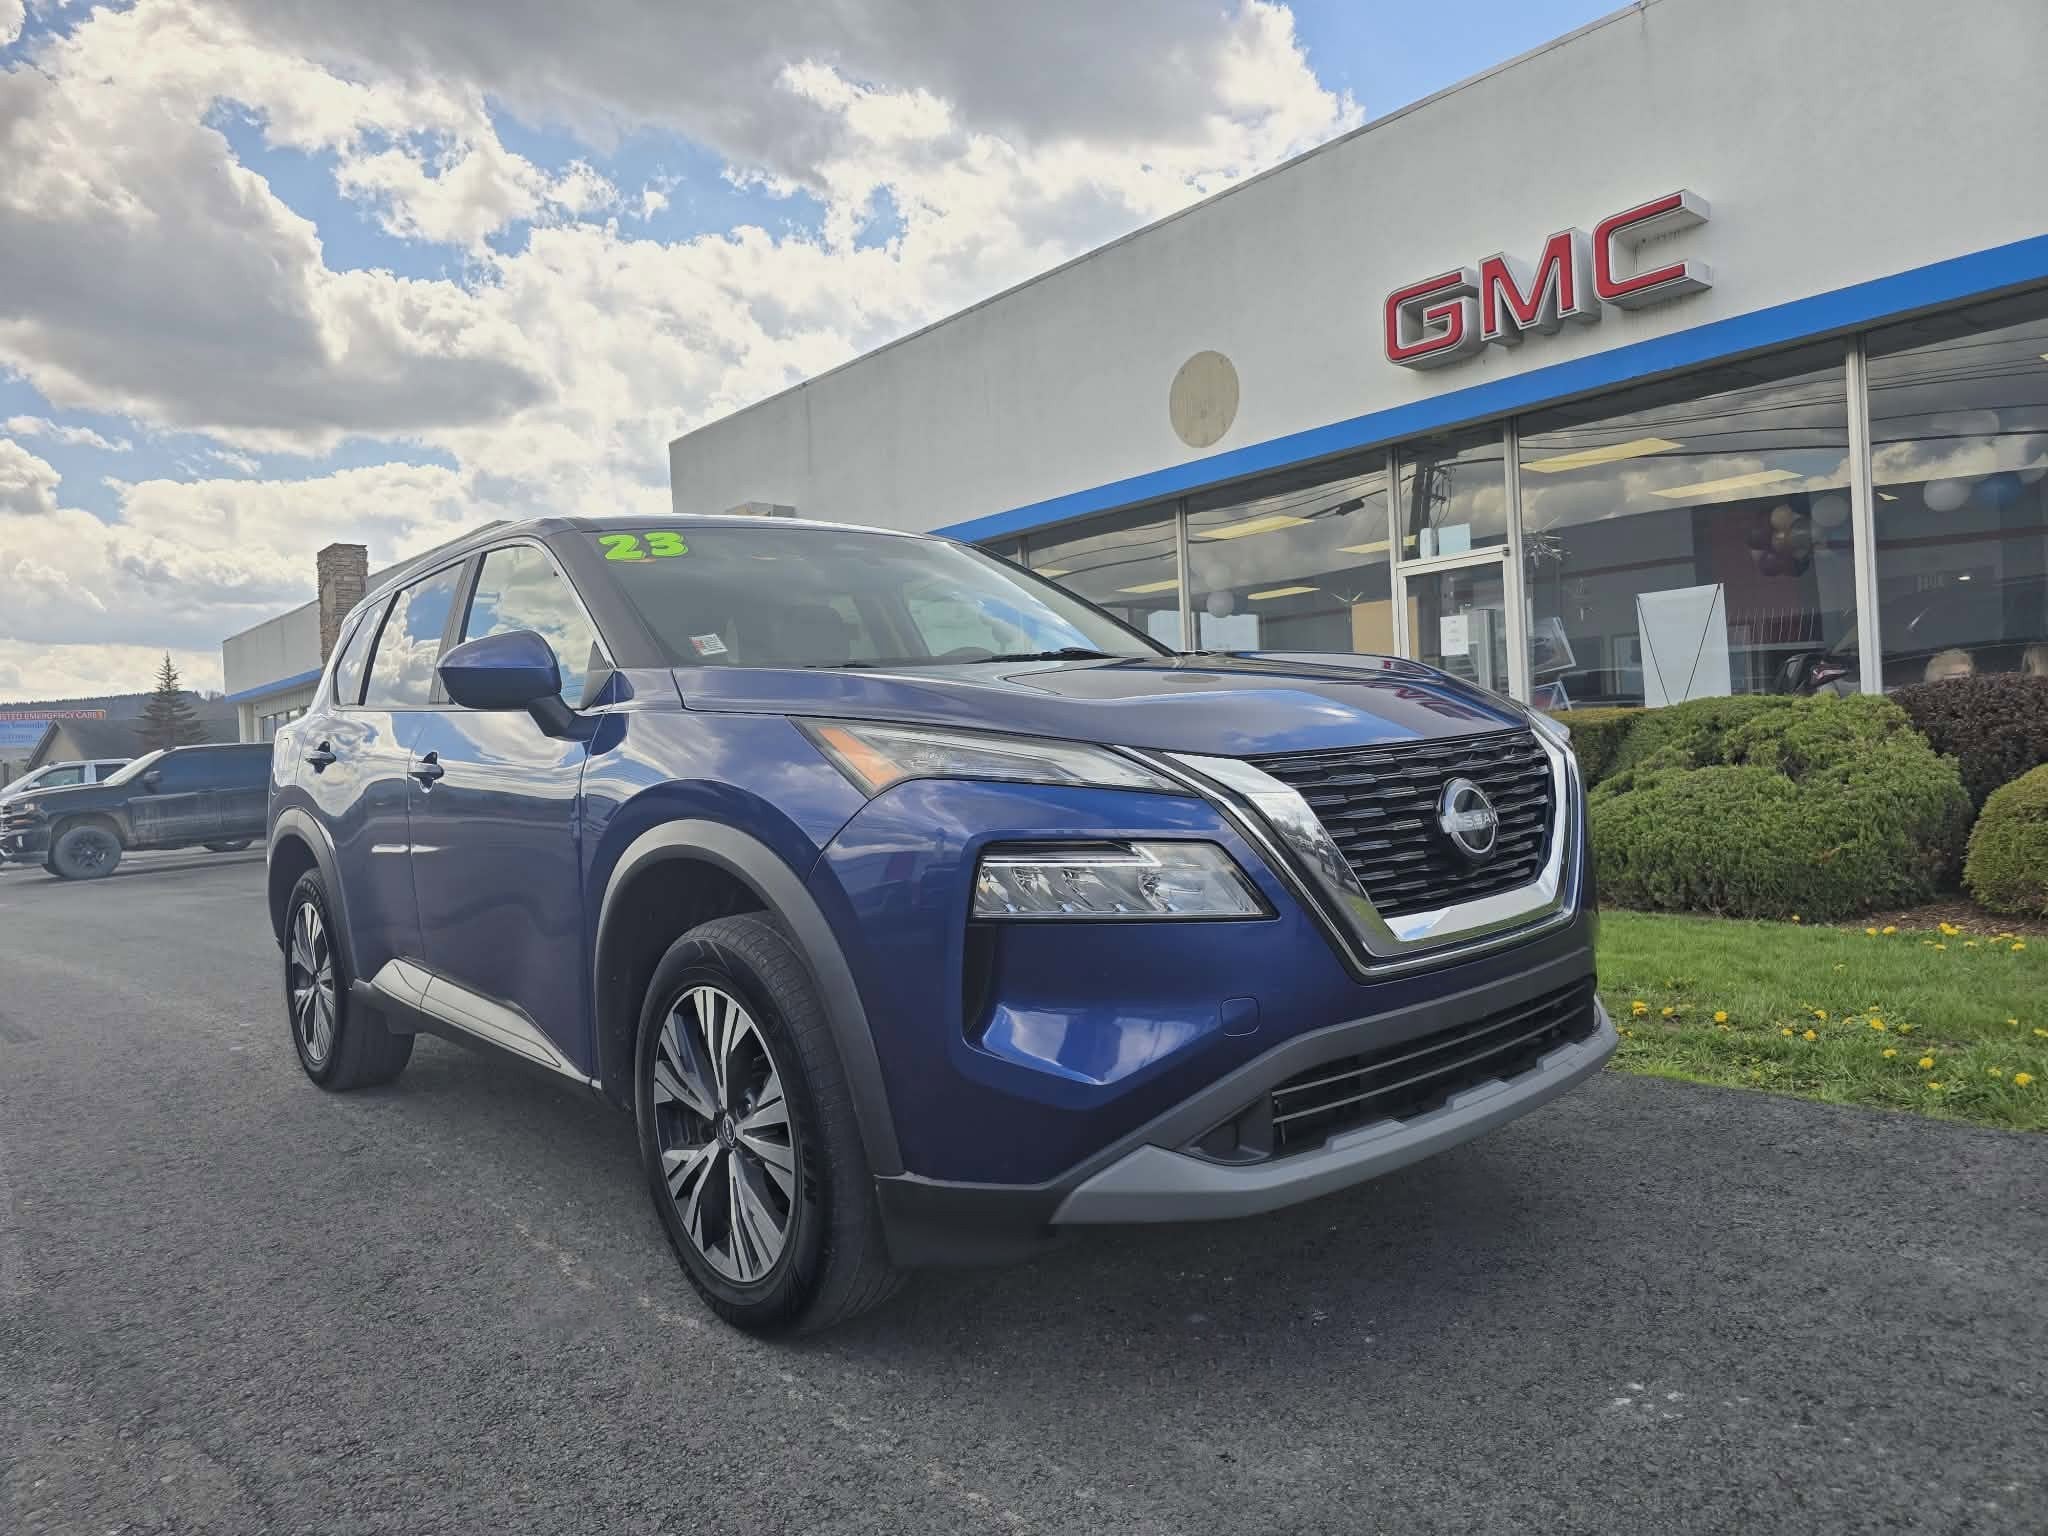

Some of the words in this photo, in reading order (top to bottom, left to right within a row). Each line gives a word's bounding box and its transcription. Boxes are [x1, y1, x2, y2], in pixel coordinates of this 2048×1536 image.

[1384, 189, 1693, 366] GMC
[598, 531, 689, 560] 23
[1443, 811, 1499, 831] SSAN
